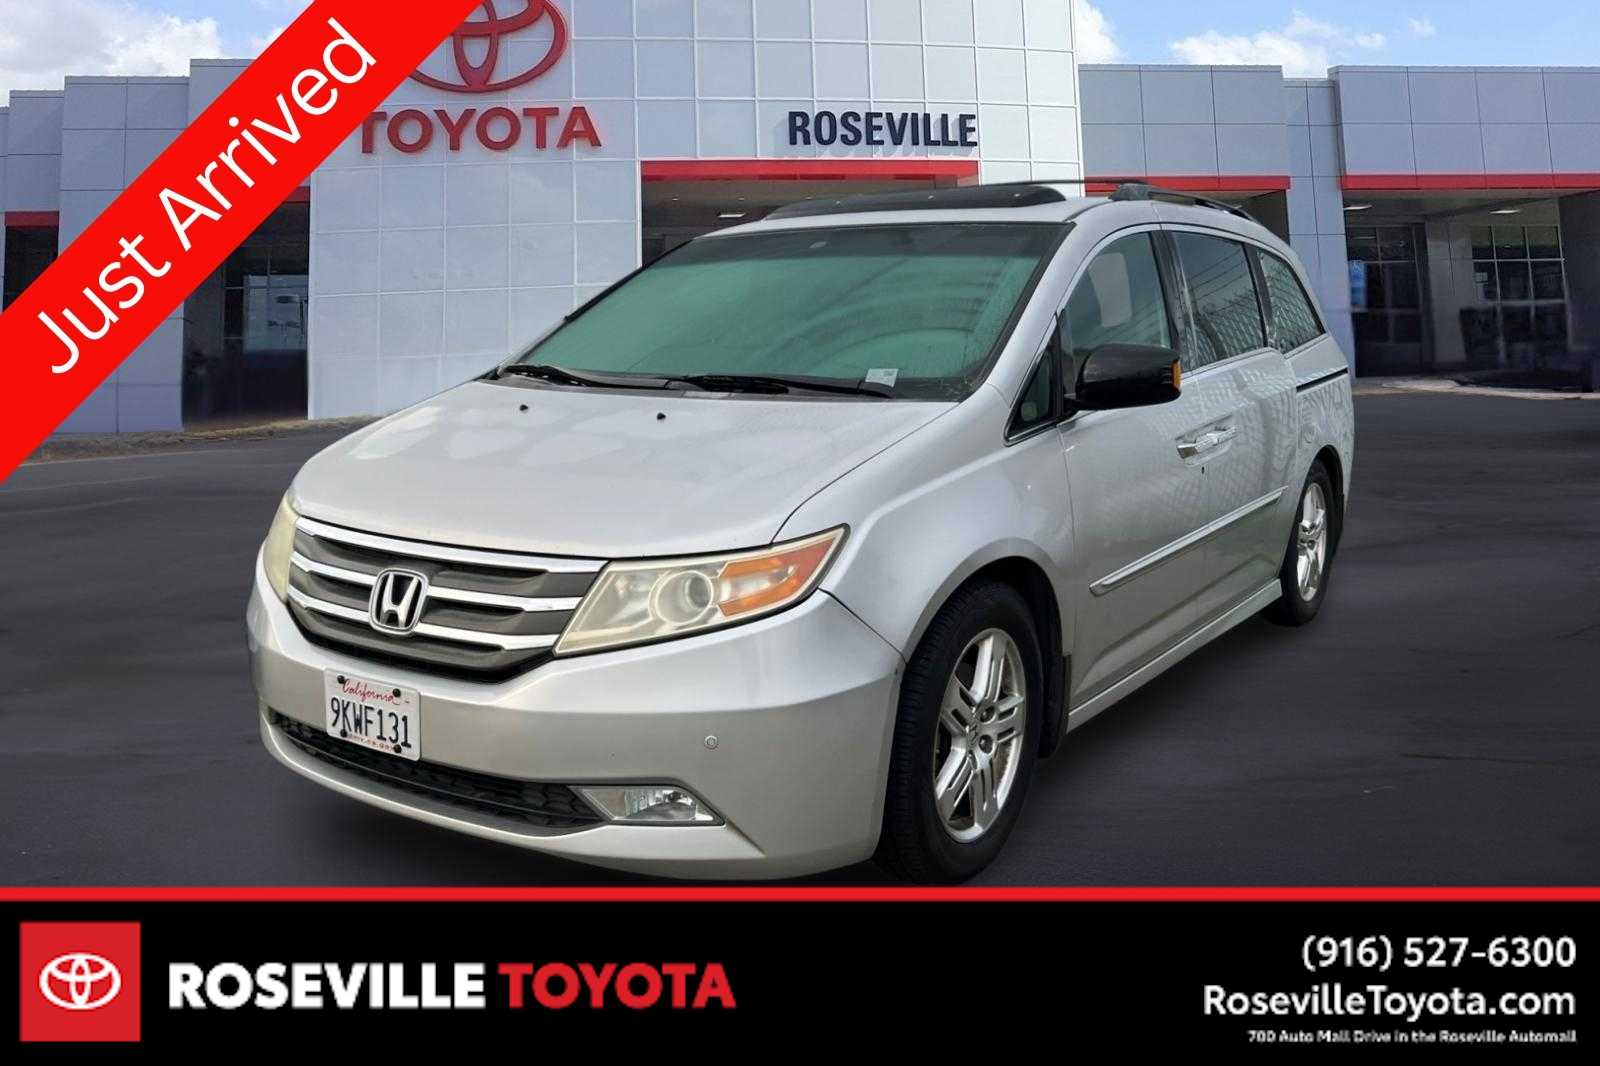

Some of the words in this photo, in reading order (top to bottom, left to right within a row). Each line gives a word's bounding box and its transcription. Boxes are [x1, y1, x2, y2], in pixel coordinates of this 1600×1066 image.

[361, 106, 602, 153] TOYOTA
[788, 111, 978, 147] ROSEVILLE
[330, 696, 412, 748] 9KWF131
